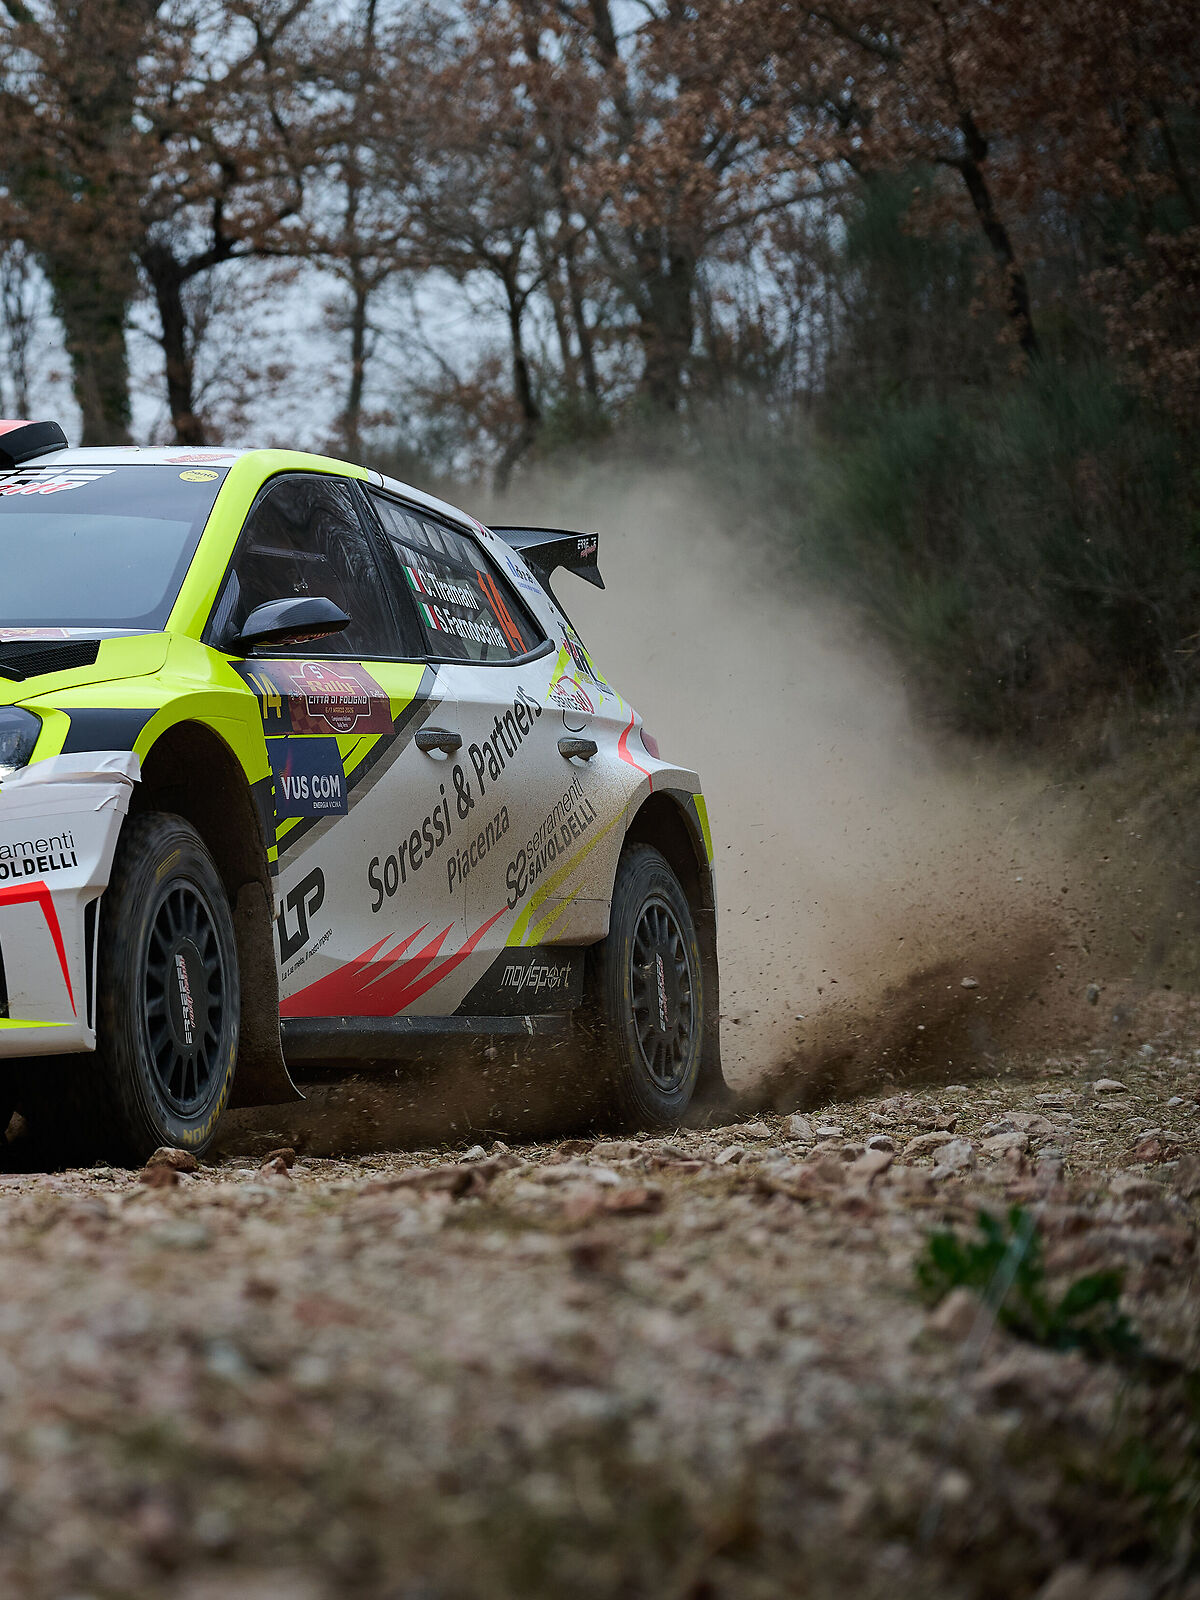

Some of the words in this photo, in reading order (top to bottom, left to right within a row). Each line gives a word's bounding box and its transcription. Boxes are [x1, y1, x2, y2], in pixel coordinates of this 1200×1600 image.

[247, 672, 282, 719] 14
[306, 680, 355, 694] Rally
[308, 694, 330, 705] CITTÀ
[339, 695, 368, 705] FOLIGNO
[280, 776, 310, 800] VUS
[311, 775, 341, 799] COM
[368, 784, 453, 913] Soressi
[453, 764, 475, 820] &
[468, 686, 543, 796] Partners
[526, 773, 585, 860] serramenti
[447, 805, 511, 893] Piacenza
[528, 799, 598, 887] SAVOLDELLI
[501, 958, 572, 995] movisport
[183, 1042, 236, 1144] SCORPION
